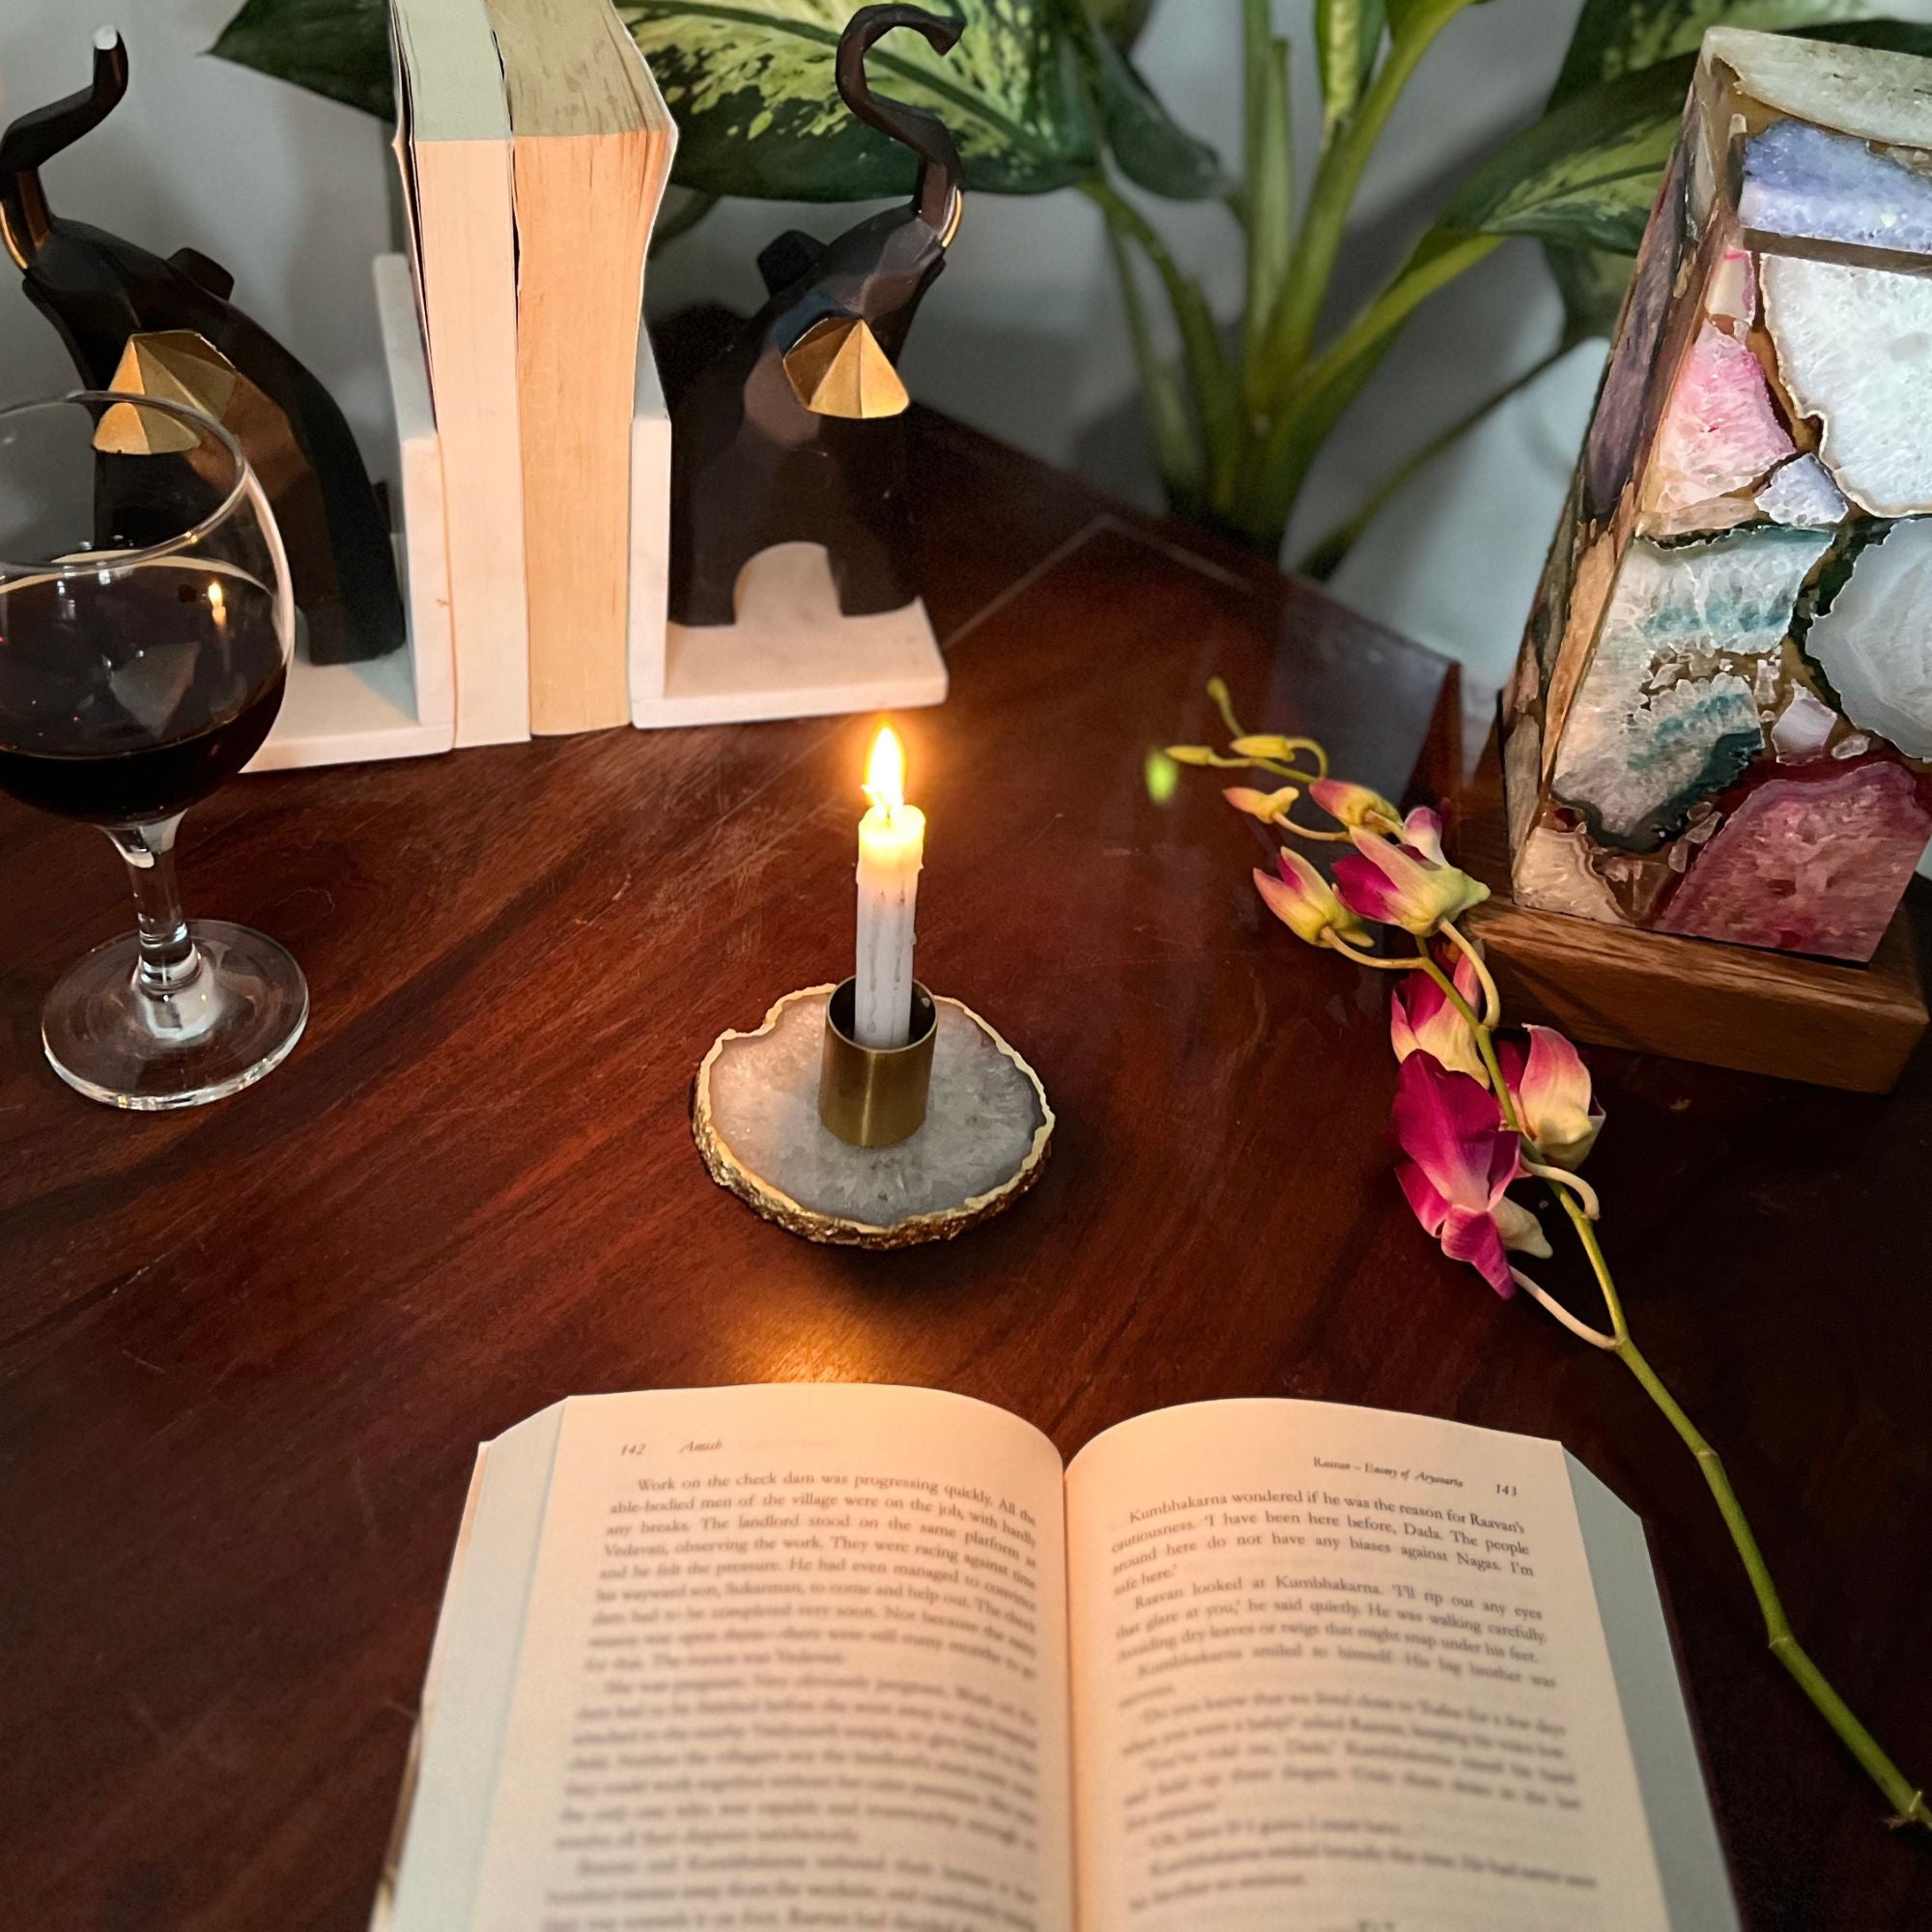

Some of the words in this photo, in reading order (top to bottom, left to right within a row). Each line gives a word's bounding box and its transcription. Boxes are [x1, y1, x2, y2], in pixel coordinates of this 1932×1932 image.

[620, 1443, 646, 1456] 142
[638, 1478, 676, 1491] Work
[682, 1479, 700, 1489] on
[707, 1475, 730, 1488] the
[736, 1472, 777, 1486] check
[783, 1471, 814, 1485] dam
[822, 1474, 847, 1484] was
[855, 1473, 938, 1494] progressing
[945, 1485, 993, 1507] quickly.
[999, 1498, 1015, 1515] All
[1020, 1509, 1036, 1526] the
[1129, 1493, 1227, 1524] Kumbhakarna
[1232, 1490, 1303, 1503] wondered
[1307, 1491, 1319, 1503] if
[1323, 1492, 1341, 1506] he
[1345, 1497, 1370, 1509] was
[1375, 1498, 1396, 1513] the
[1399, 1503, 1443, 1520] reason
[1447, 1508, 1466, 1523] for
[1495, 1484, 1518, 1497] 143
[606, 1524, 632, 1537] any
[641, 1520, 691, 1533] breaks.
[700, 1517, 729, 1530] The
[738, 1514, 799, 1528] landlord
[809, 1514, 850, 1527] stood
[860, 1518, 878, 1528] on
[889, 1518, 911, 1530] the
[920, 1523, 956, 1538] same
[965, 1530, 1019, 1560] platform
[611, 1497, 695, 1514] able-bodied
[701, 1497, 732, 1509] men
[738, 1493, 756, 1506] of
[763, 1493, 785, 1505] the
[792, 1492, 838, 1508] village
[844, 1495, 879, 1507] were
[885, 1498, 903, 1509] on
[911, 1496, 933, 1513] the
[939, 1504, 964, 1521] job,
[970, 1509, 997, 1529] with
[1003, 1520, 1036, 1549] hardly
[1112, 1519, 1197, 1553] cautiousness.
[1224, 1513, 1258, 1525] have
[1265, 1511, 1300, 1523] been
[1308, 1512, 1339, 1526] here
[1348, 1515, 1397, 1534] before,
[1404, 1522, 1444, 1540] Dada.
[1450, 1529, 1478, 1547] The
[1486, 1538, 1530, 1557] people
[675, 1540, 749, 1553] observing
[753, 1536, 777, 1549] the
[783, 1535, 824, 1549] work.
[831, 1535, 868, 1553] They
[874, 1540, 909, 1552] were
[916, 1544, 958, 1564] racing
[964, 1553, 1008, 1572] against
[1113, 1547, 1157, 1576] around
[1167, 1543, 1197, 1555] here
[1208, 1536, 1226, 1548] do
[1236, 1535, 1263, 1546] not
[1271, 1531, 1305, 1546] have
[1316, 1536, 1341, 1550] any
[1350, 1536, 1391, 1553] biases
[1401, 1545, 1448, 1561] against
[1457, 1551, 1502, 1572] Nagas.
[1114, 1577, 1138, 1596] safe
[1135, 1587, 1183, 1609] Raavan
[1193, 1576, 1242, 1595] looked
[1252, 1577, 1266, 1588] at
[1424, 1591, 1443, 1606] rip
[1452, 1595, 1474, 1608] out
[1484, 1602, 1506, 1615] any
[1515, 1607, 1543, 1621] eyes
[1146, 1612, 1179, 1633] glare
[1185, 1607, 1199, 1619] at
[1248, 1598, 1266, 1611] he
[1274, 1598, 1302, 1611] said
[1369, 1604, 1390, 1618] He
[1398, 1608, 1423, 1622] was
[1430, 1614, 1482, 1635] walking
